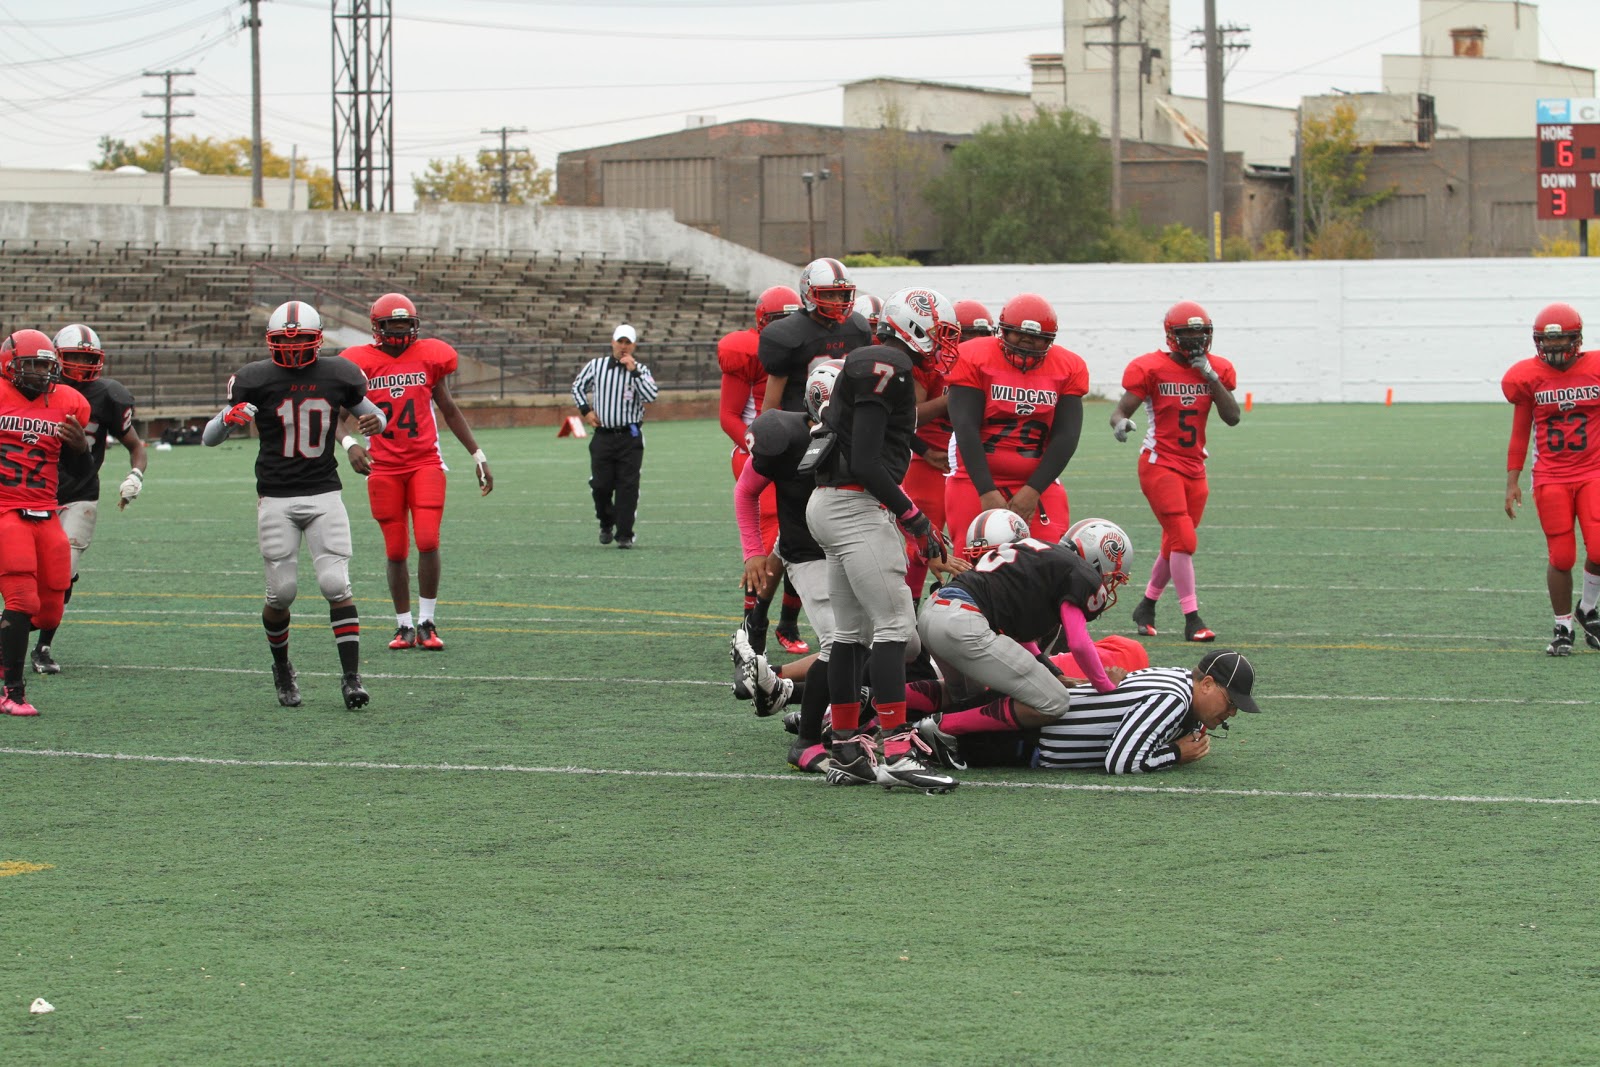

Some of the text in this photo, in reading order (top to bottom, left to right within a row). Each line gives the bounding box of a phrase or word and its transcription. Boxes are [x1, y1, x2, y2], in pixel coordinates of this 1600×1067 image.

[1540, 126, 1574, 140] HOME
[1557, 140, 1574, 167] 6
[1541, 173, 1576, 188] DOWN
[1551, 188, 1567, 215] 3
[368, 371, 427, 391] WILDCATS
[872, 361, 895, 394] 7
[1158, 382, 1212, 397] WILDCAT
[1534, 385, 1600, 406] WILDCATS
[276, 398, 332, 459] 10
[374, 398, 419, 440] 24
[1177, 409, 1199, 448] 5
[1546, 412, 1588, 452] 63
[983, 417, 1050, 459] 79
[0, 443, 47, 489] 52
